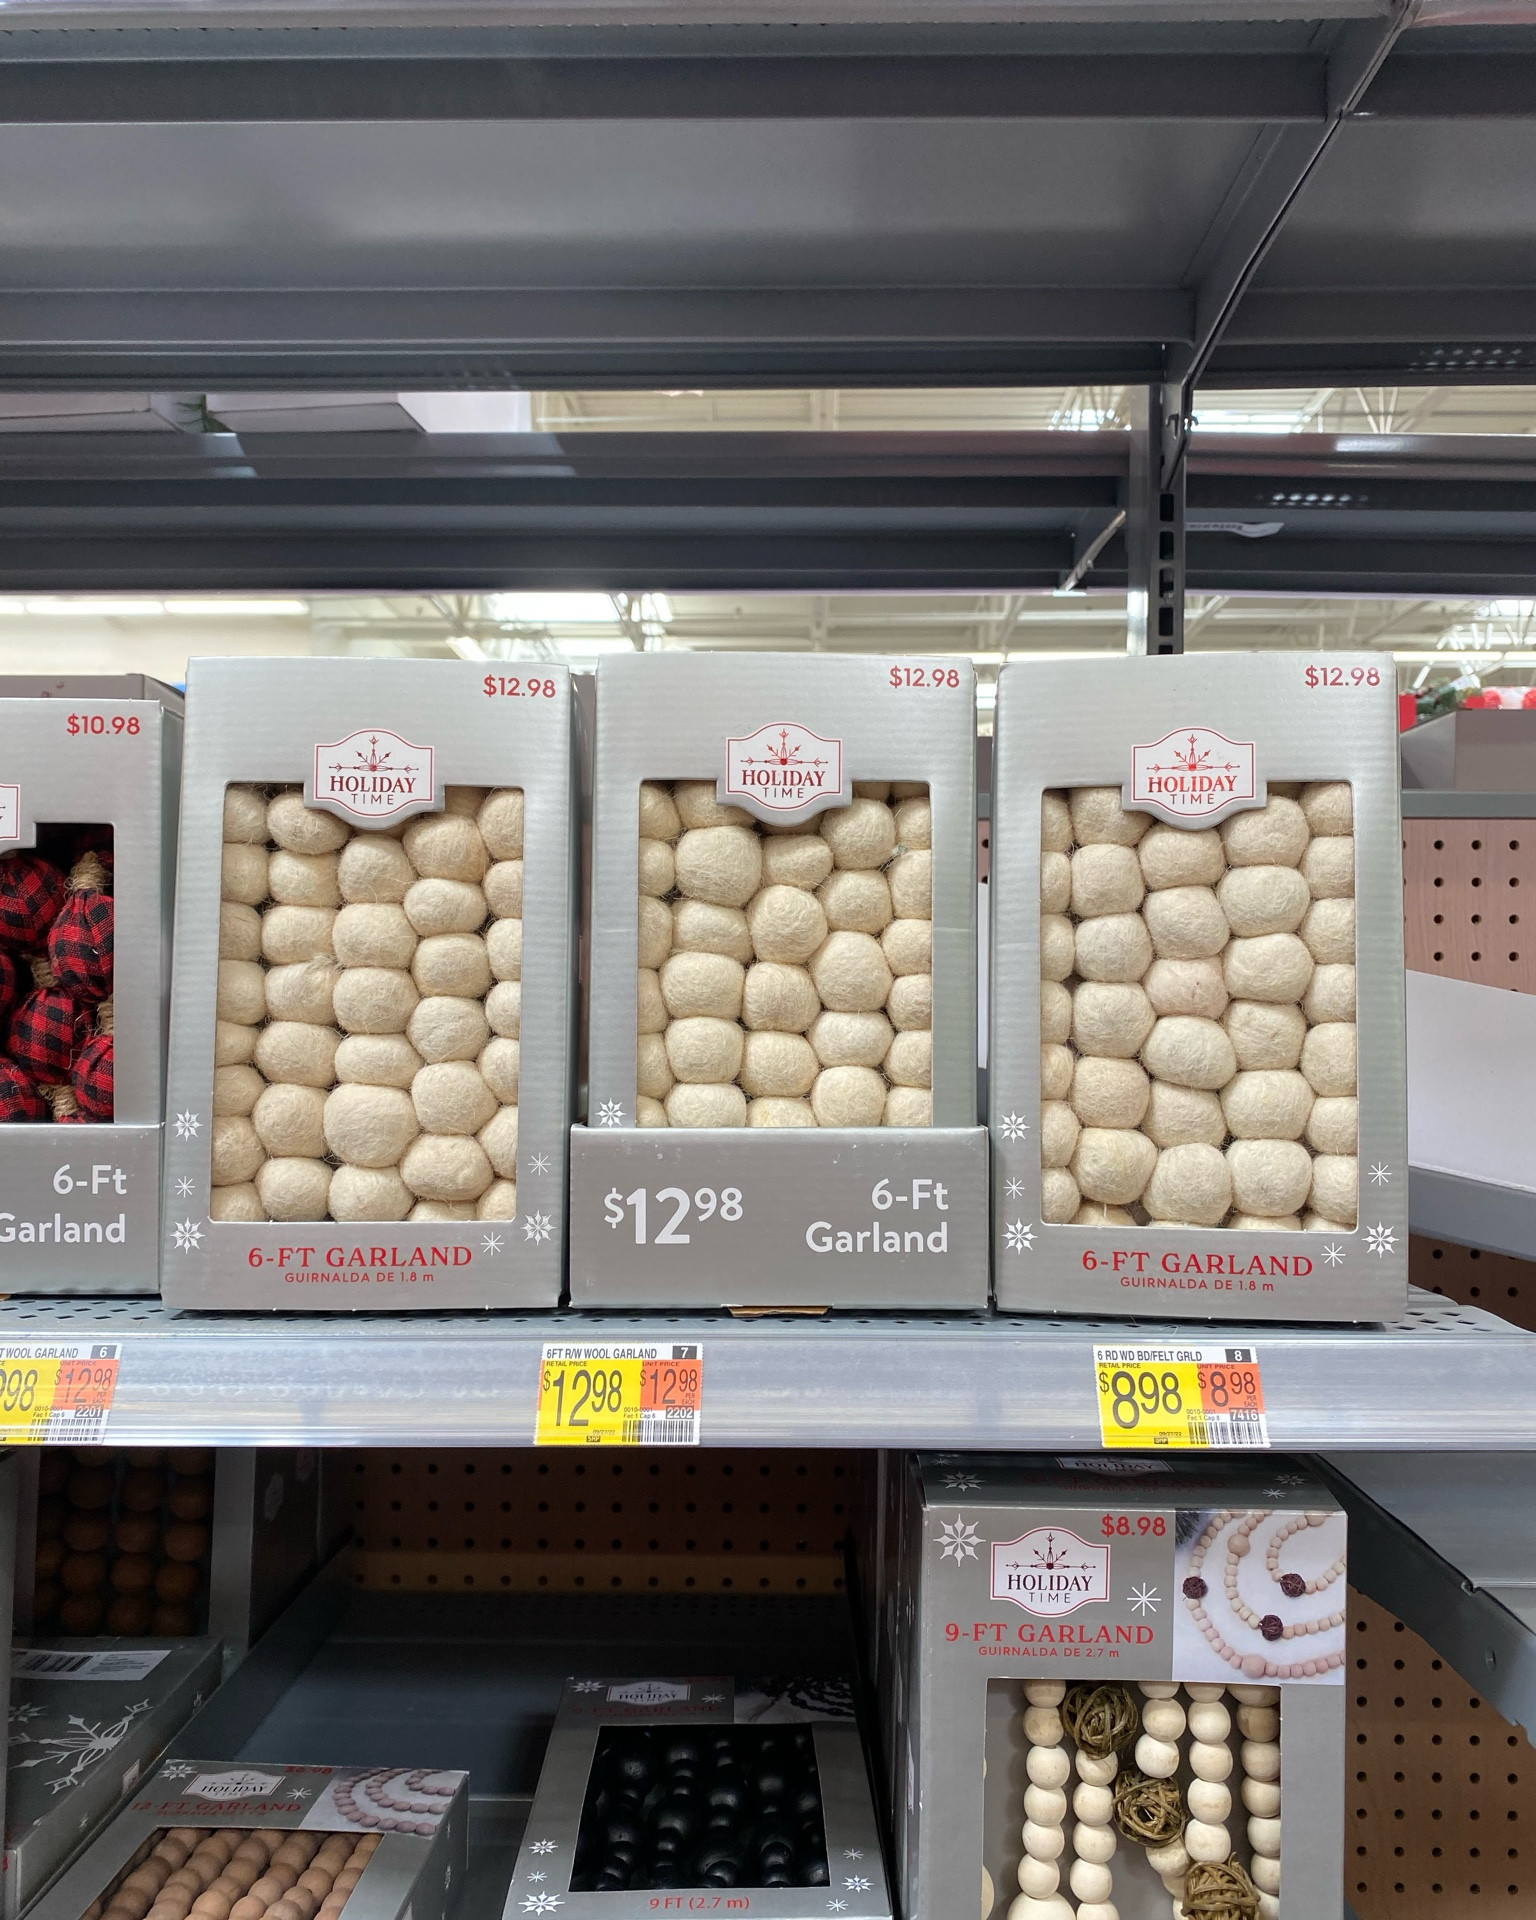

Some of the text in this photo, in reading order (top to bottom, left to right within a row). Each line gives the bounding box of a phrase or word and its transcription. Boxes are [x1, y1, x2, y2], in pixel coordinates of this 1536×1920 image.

[889, 665, 960, 688] $12.98
[1305, 664, 1381, 688] $12.98
[482, 674, 556, 698] $12.98
[66, 713, 140, 736] $10.98
[329, 775, 416, 793] HOLIDAY
[741, 769, 826, 787] HOLIDAY
[1148, 775, 1238, 793] HOLIDAY
[351, 793, 394, 805] TIME
[762, 787, 804, 799] TIME
[1170, 793, 1215, 805] TIME
[53, 1164, 127, 1195] 6-Ft
[871, 1178, 949, 1210] 6-Ft
[0, 1212, 126, 1243] Garland
[805, 1221, 948, 1253] Garland
[248, 1246, 472, 1267] 6-FT GARLAND
[1082, 1250, 1313, 1277] 6-FT GARLAND
[285, 1271, 434, 1283] GUIRNALDA DE 1.8 m
[1120, 1277, 1274, 1291] GUIRNALDA DE 1.8 m
[6, 1348, 32, 1358] WOOL
[34, 1348, 79, 1358] GARLAND
[100, 1346, 107, 1358] 6
[546, 1348, 657, 1359] 6FT R/W WOOL GARLAND
[680, 1347, 689, 1358] 7
[1097, 1350, 1202, 1362] 6 RD WD BD/FELT GRLD
[1234, 1350, 1243, 1361] 8
[75, 1406, 102, 1418] 2201
[666, 1407, 693, 1418] 2202
[1231, 1409, 1258, 1421] 7416
[1101, 1513, 1166, 1537] $8.98
[1007, 1574, 1093, 1591] HOLIDAY
[1029, 1592, 1071, 1603] TIME
[945, 1623, 1154, 1644] 9-FT GARLAND
[978, 1646, 1119, 1658] GUIRNALDA DE 2.7 m
[201, 1785, 267, 1794] HOLIDAY
[196, 1801, 302, 1813] GARLAND
[650, 1896, 750, 1911] 9 FT (2.7 m)
